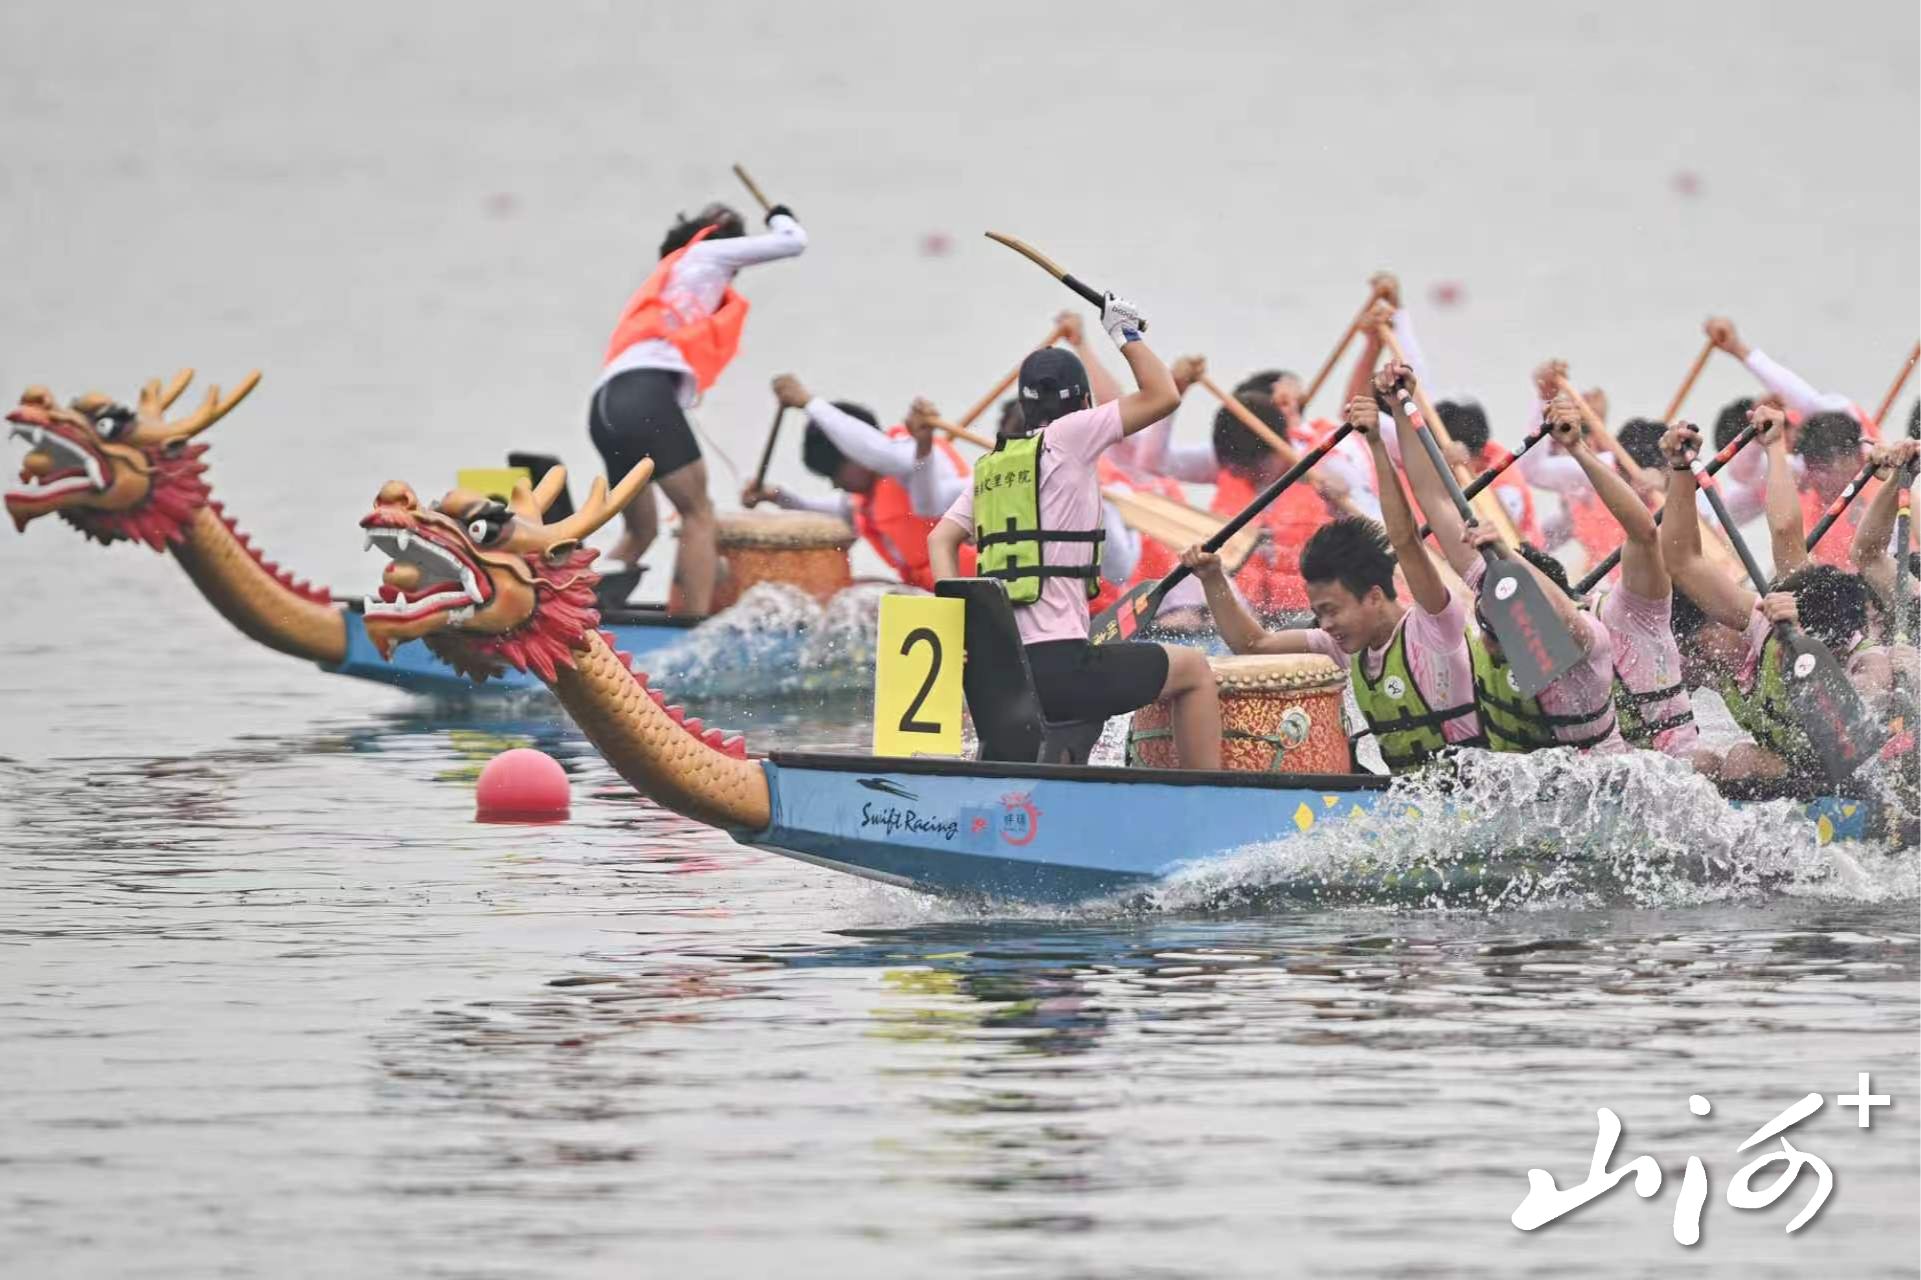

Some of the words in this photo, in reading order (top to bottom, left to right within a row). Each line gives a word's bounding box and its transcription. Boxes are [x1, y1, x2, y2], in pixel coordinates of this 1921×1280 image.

[899, 627, 942, 734] 2
[861, 801, 902, 836] Swift
[901, 810, 959, 840] Racing
